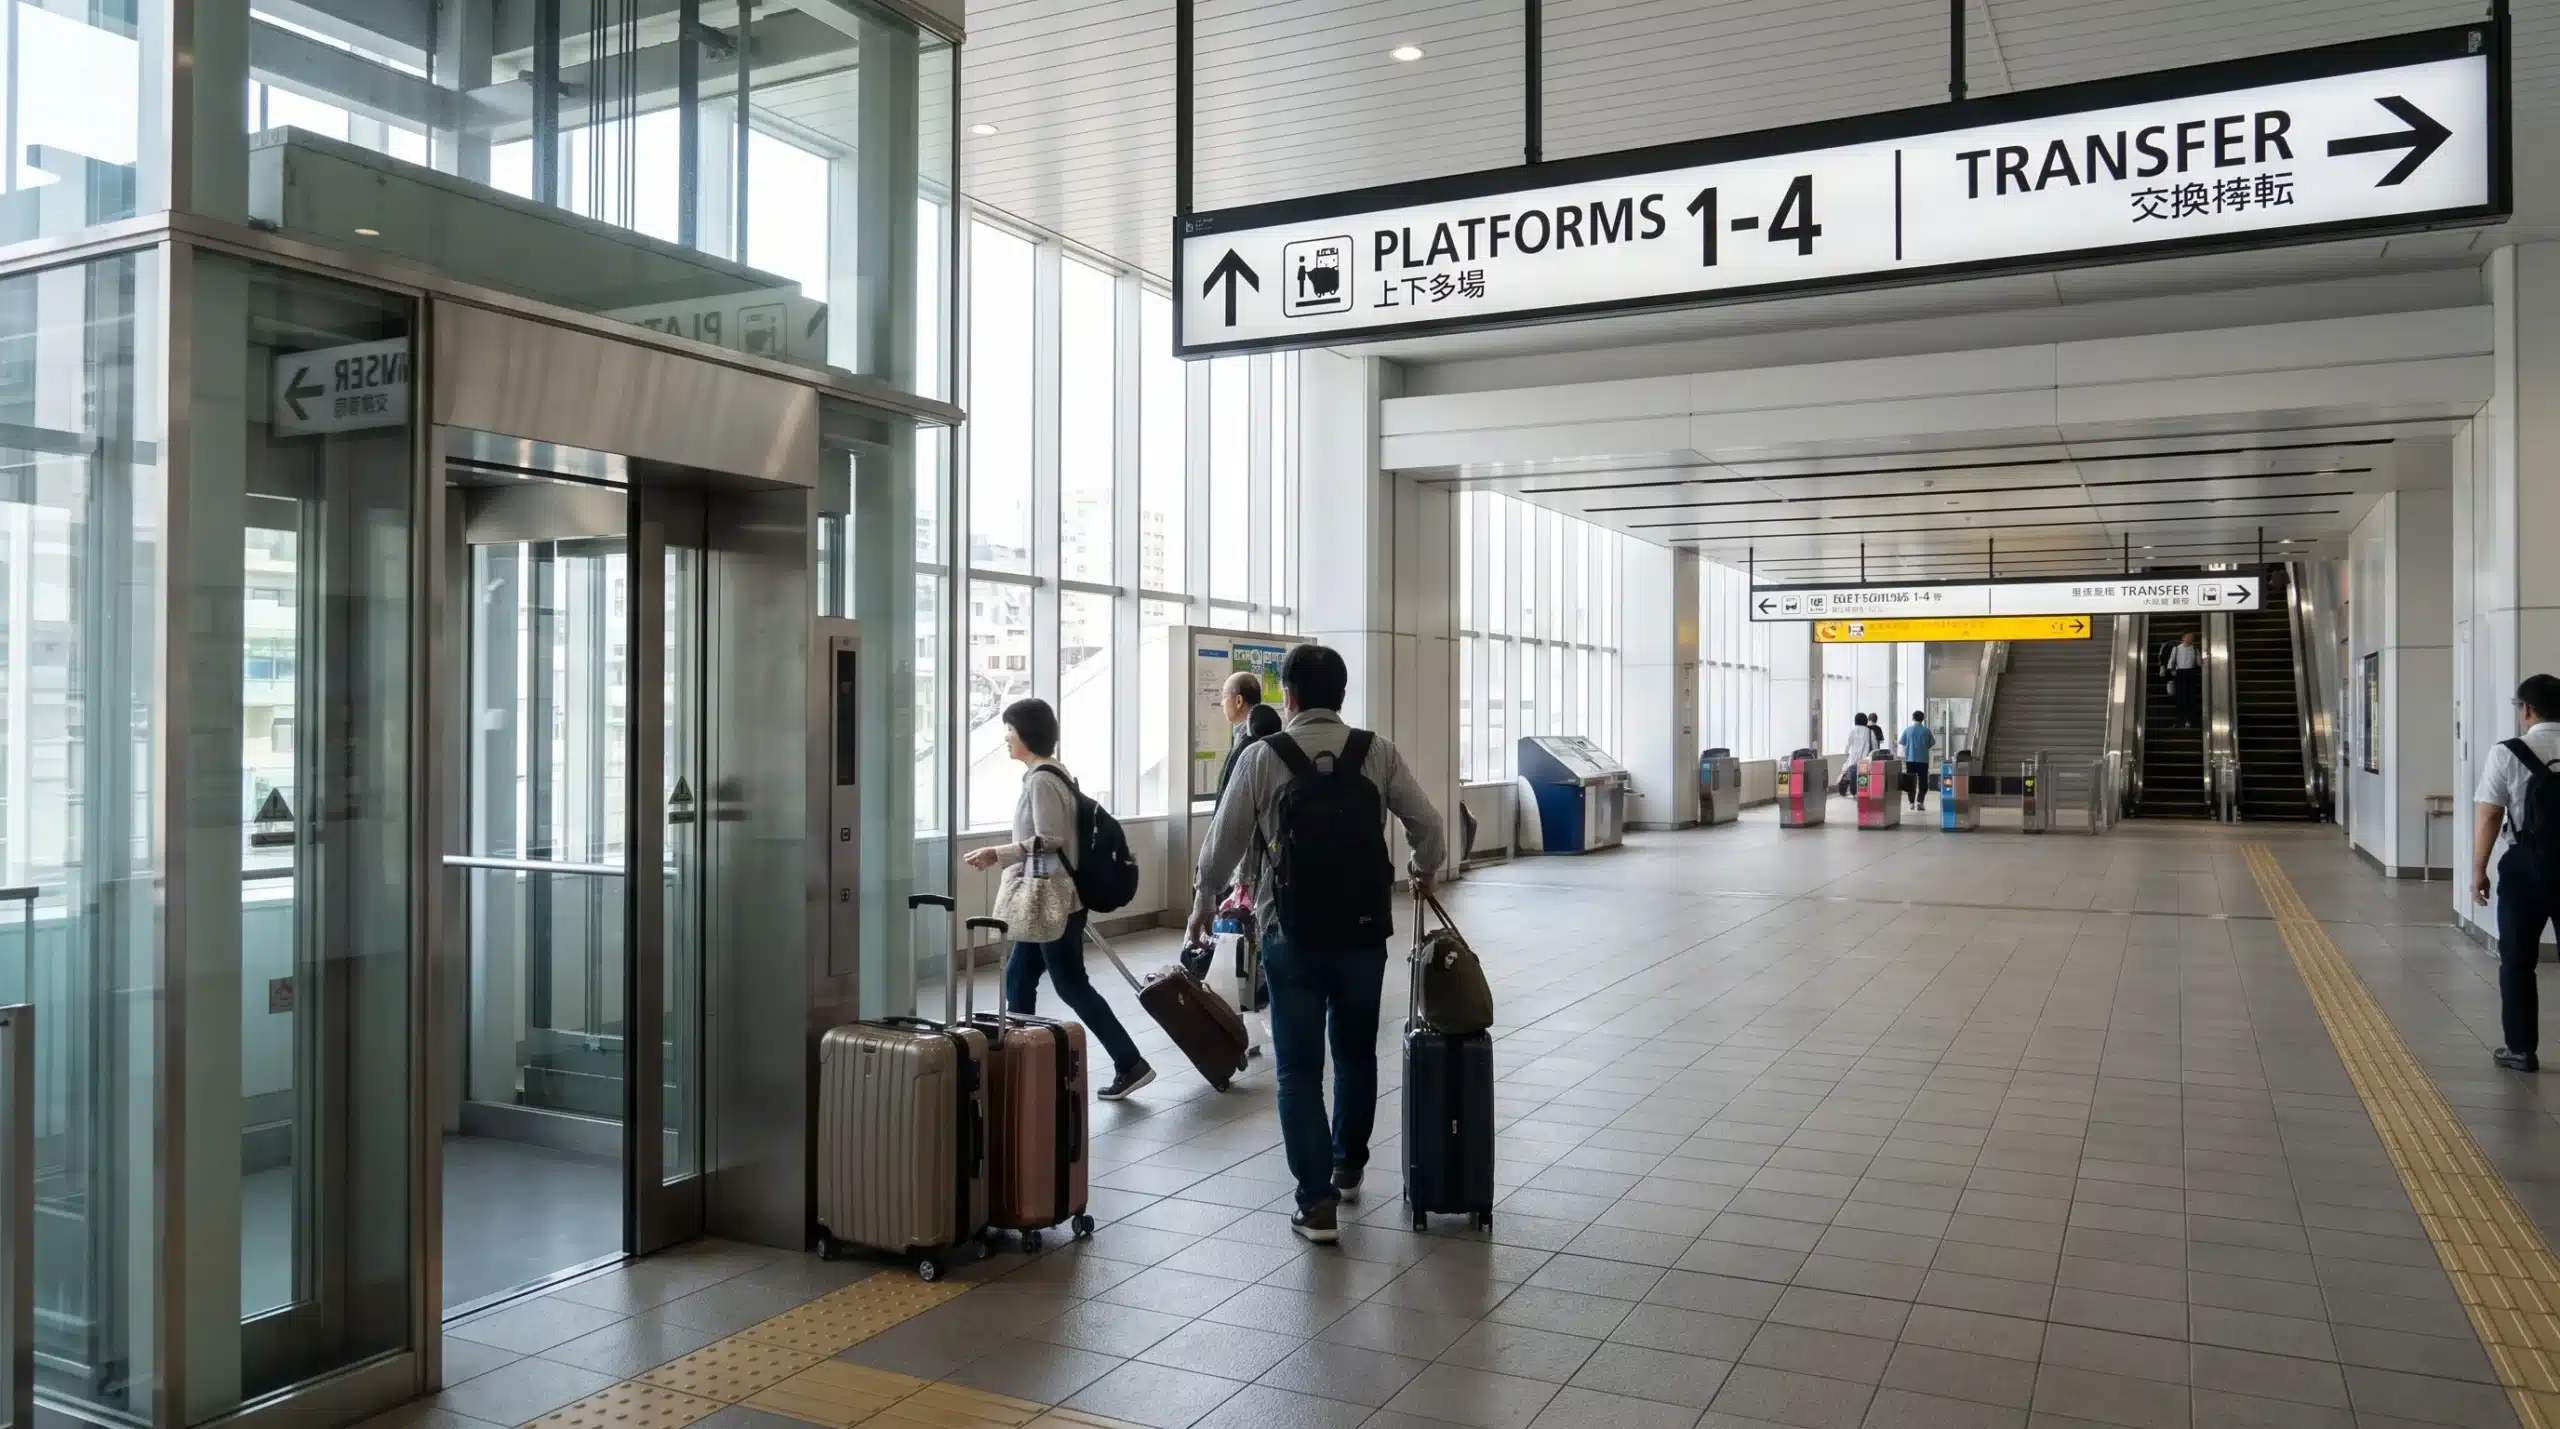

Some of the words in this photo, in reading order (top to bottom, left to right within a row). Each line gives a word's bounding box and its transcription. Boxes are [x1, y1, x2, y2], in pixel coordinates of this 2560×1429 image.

[1955, 110, 2294, 199] TRANSFER
[1374, 193, 1666, 272] PLATFORMS
[1686, 174, 1822, 267] 1-4
[1373, 269, 1486, 308] 上下多場
[2120, 584, 2189, 597] TRANSFER
